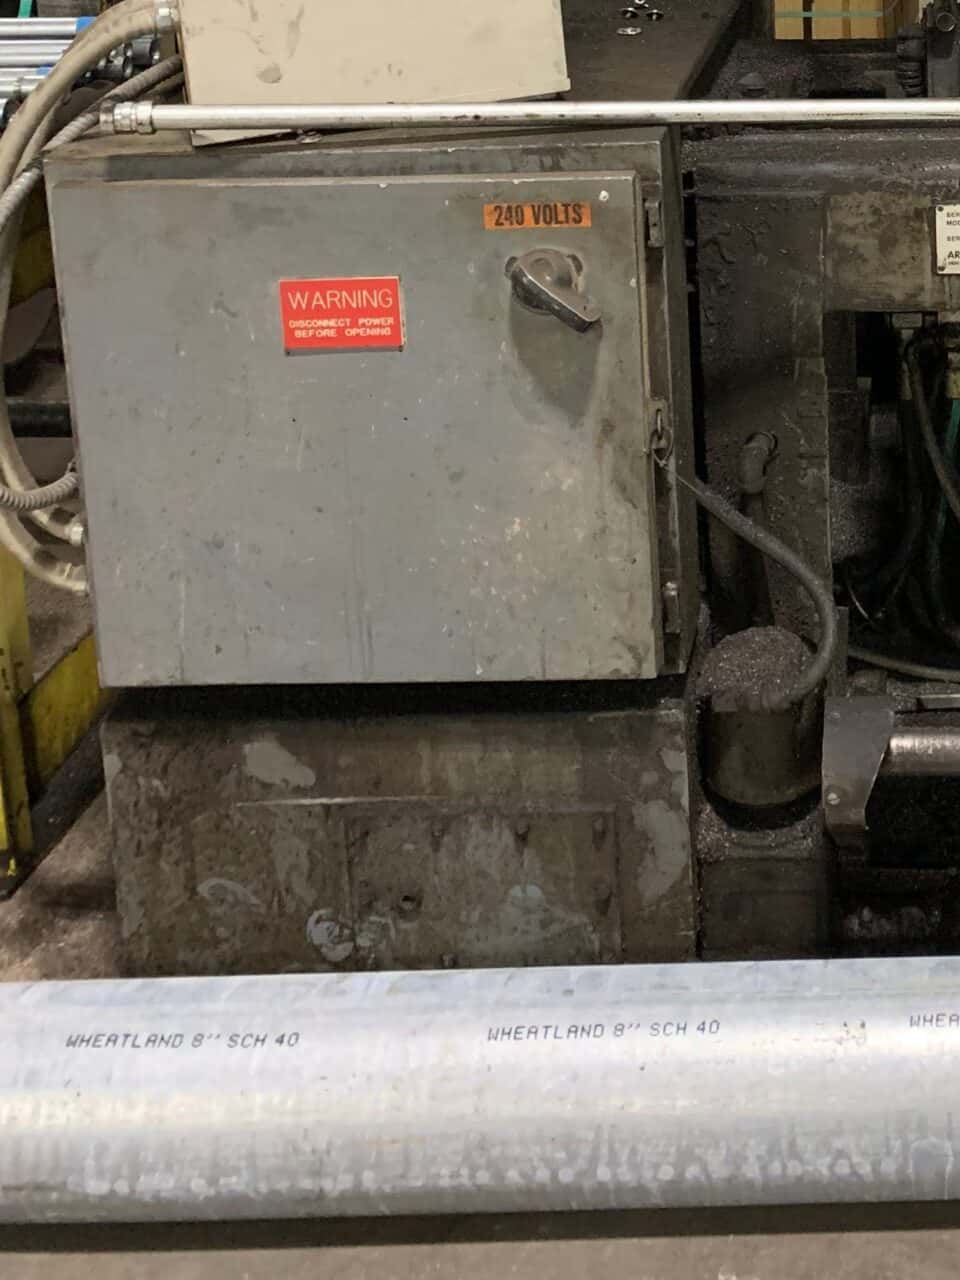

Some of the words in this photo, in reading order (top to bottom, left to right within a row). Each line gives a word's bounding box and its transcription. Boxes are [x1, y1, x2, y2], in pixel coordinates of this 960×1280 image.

[494, 204, 525, 226] 240
[531, 203, 583, 225] VOLTS
[287, 288, 393, 310] WARNING
[289, 318, 351, 328] DISCONNECT
[358, 317, 394, 326] POWER
[294, 329, 337, 338] BEFORE
[345, 327, 391, 337] OPENING
[65, 1033, 185, 1048] WHEATLAND
[226, 1032, 268, 1048] SCH
[274, 1031, 301, 1047] 40
[487, 1023, 605, 1041] WHEATLAND
[649, 1021, 688, 1037] SCH
[696, 1019, 721, 1035] 40
